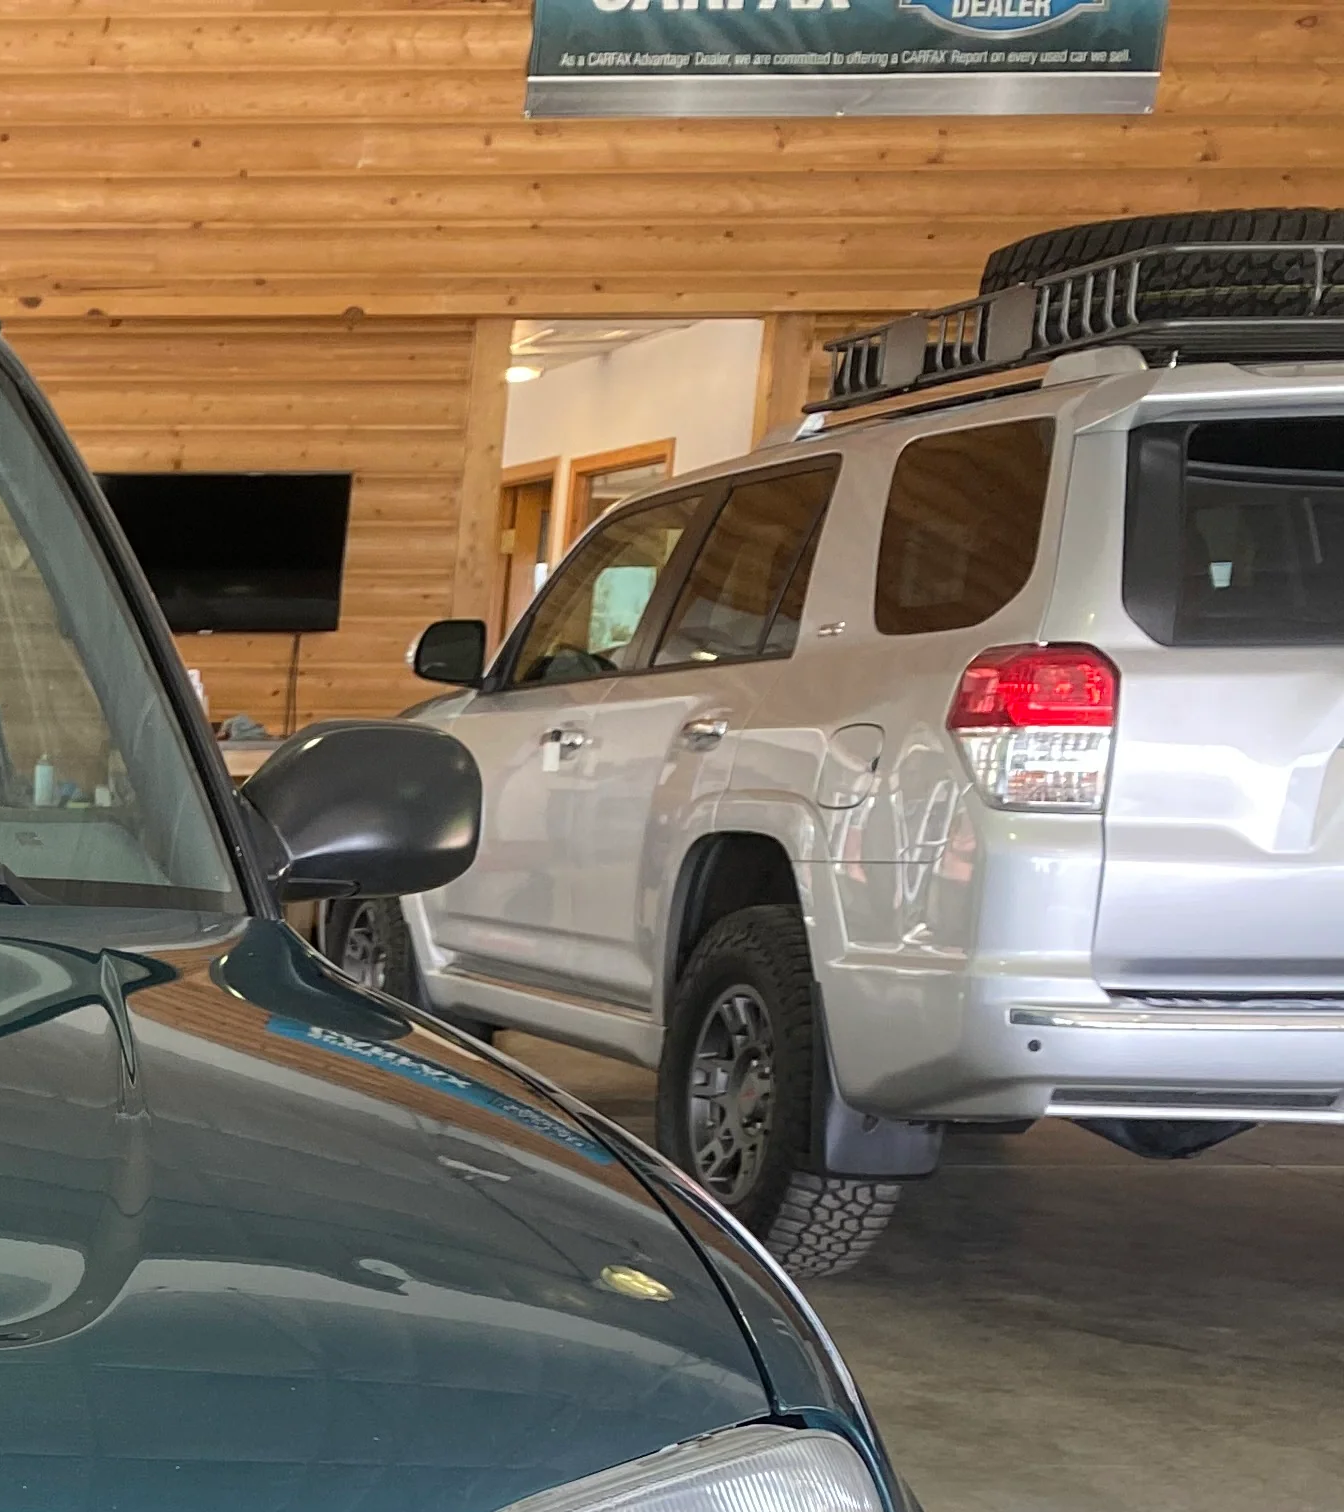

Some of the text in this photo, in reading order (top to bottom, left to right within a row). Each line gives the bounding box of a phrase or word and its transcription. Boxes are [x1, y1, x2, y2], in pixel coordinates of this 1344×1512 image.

[560, 52, 575, 66] As
[588, 51, 632, 66] CARFAX
[734, 53, 751, 65] we
[752, 53, 772, 65] are
[773, 51, 831, 65] committed
[832, 51, 845, 65] to
[846, 51, 889, 67] offering
[890, 53, 899, 65] a
[901, 50, 946, 64] CARFAX
[951, 50, 988, 65] Report
[990, 51, 1006, 63] on
[1007, 51, 1039, 65] every
[1040, 49, 1069, 63] used
[1069, 51, 1088, 63] car
[1090, 51, 1107, 62] we
[1109, 49, 1132, 63] sell.
